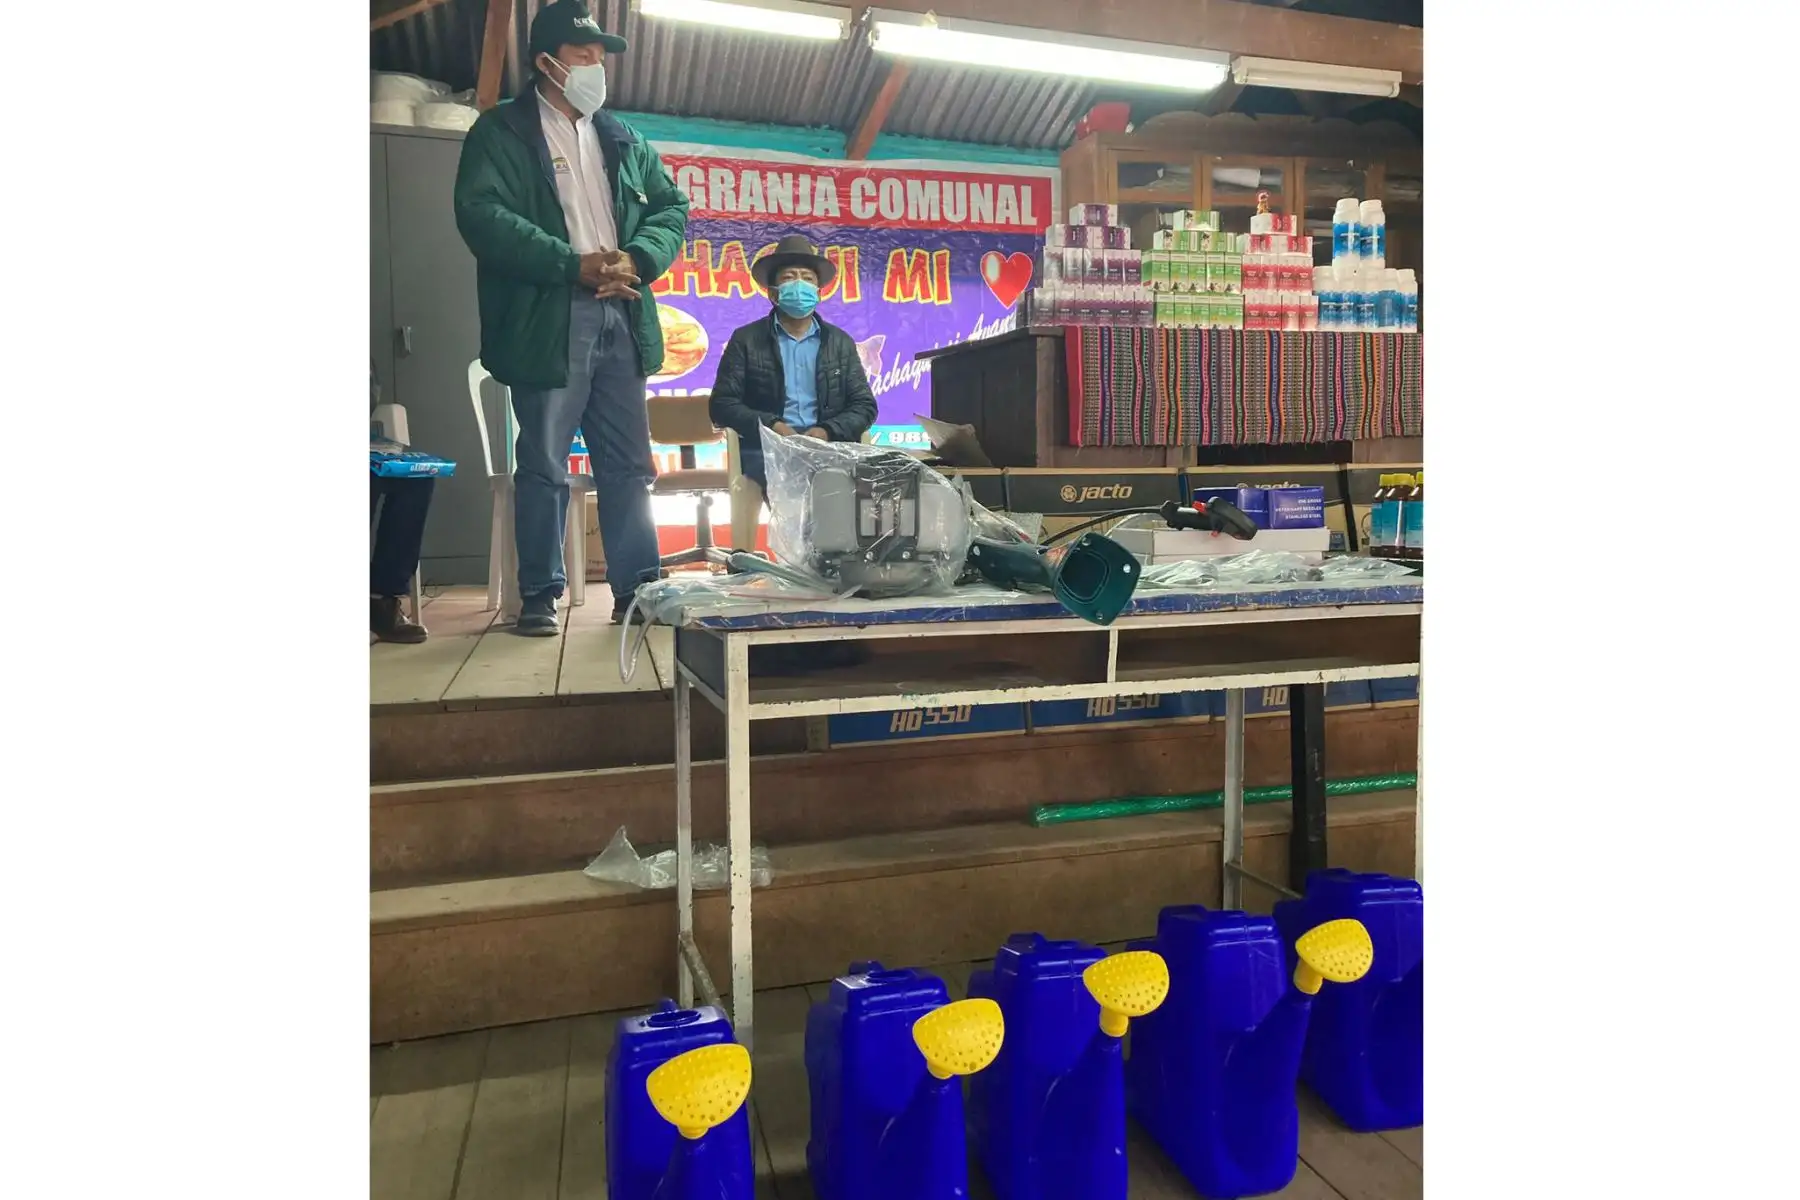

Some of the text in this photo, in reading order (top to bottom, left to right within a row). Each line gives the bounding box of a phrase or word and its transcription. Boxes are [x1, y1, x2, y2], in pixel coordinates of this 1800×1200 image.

[849, 177, 1038, 226] COMUNAL
[882, 247, 953, 305] MI
[1076, 483, 1133, 503] jacto
